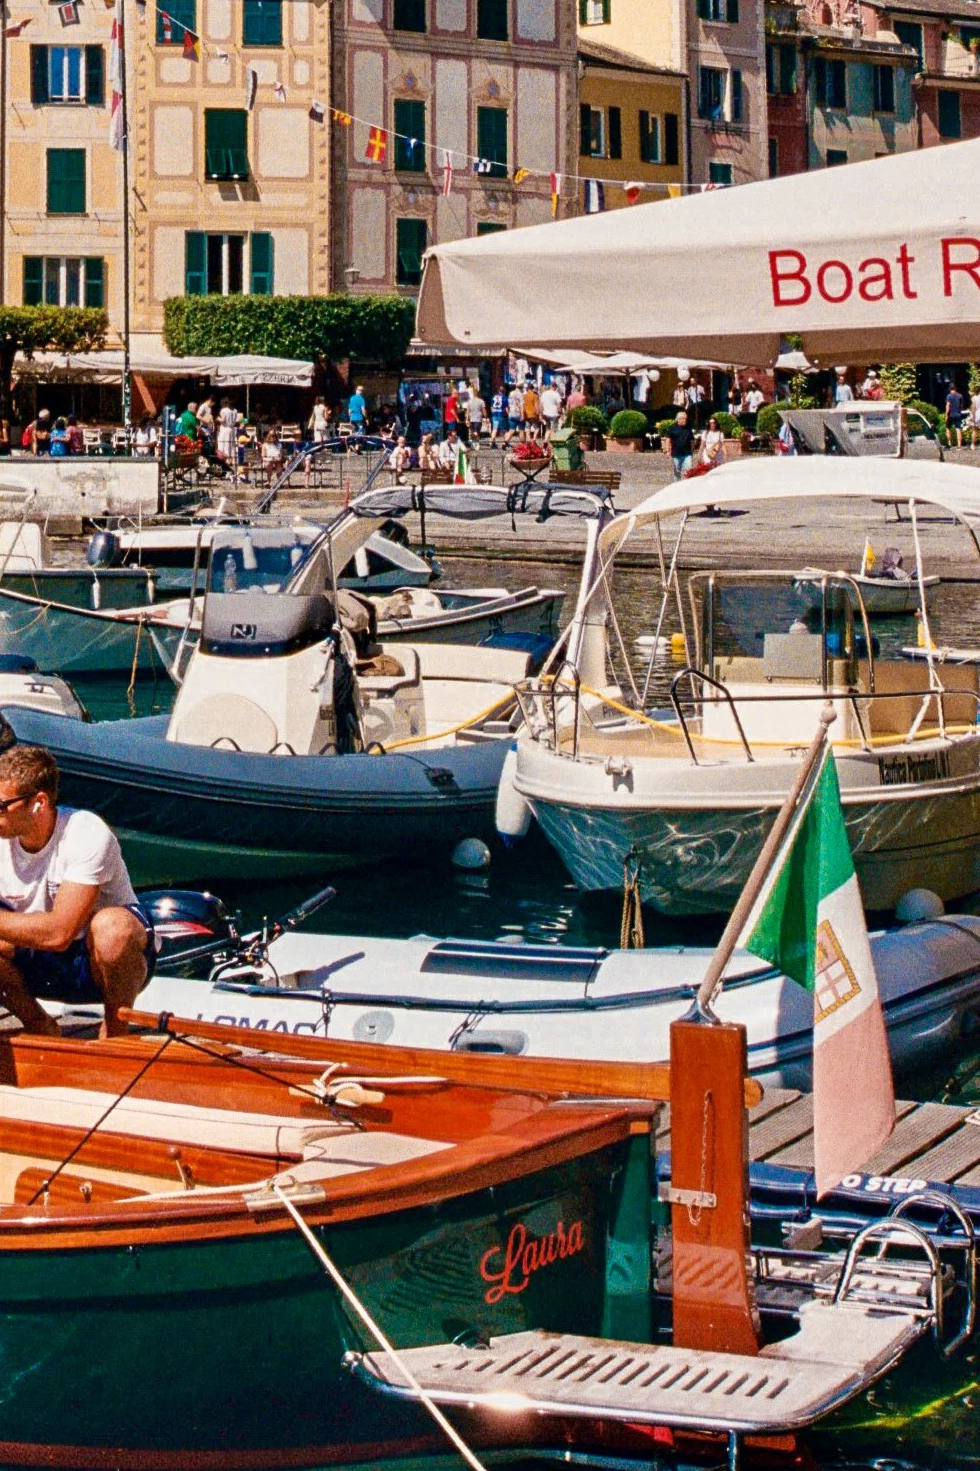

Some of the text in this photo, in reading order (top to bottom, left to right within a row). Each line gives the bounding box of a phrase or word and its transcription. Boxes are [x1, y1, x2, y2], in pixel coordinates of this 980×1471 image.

[768, 237, 980, 307] Boat R
[197, 1013, 317, 1035] OMAC
[865, 1177, 928, 1193] STEP
[480, 1220, 584, 1304] Laura
